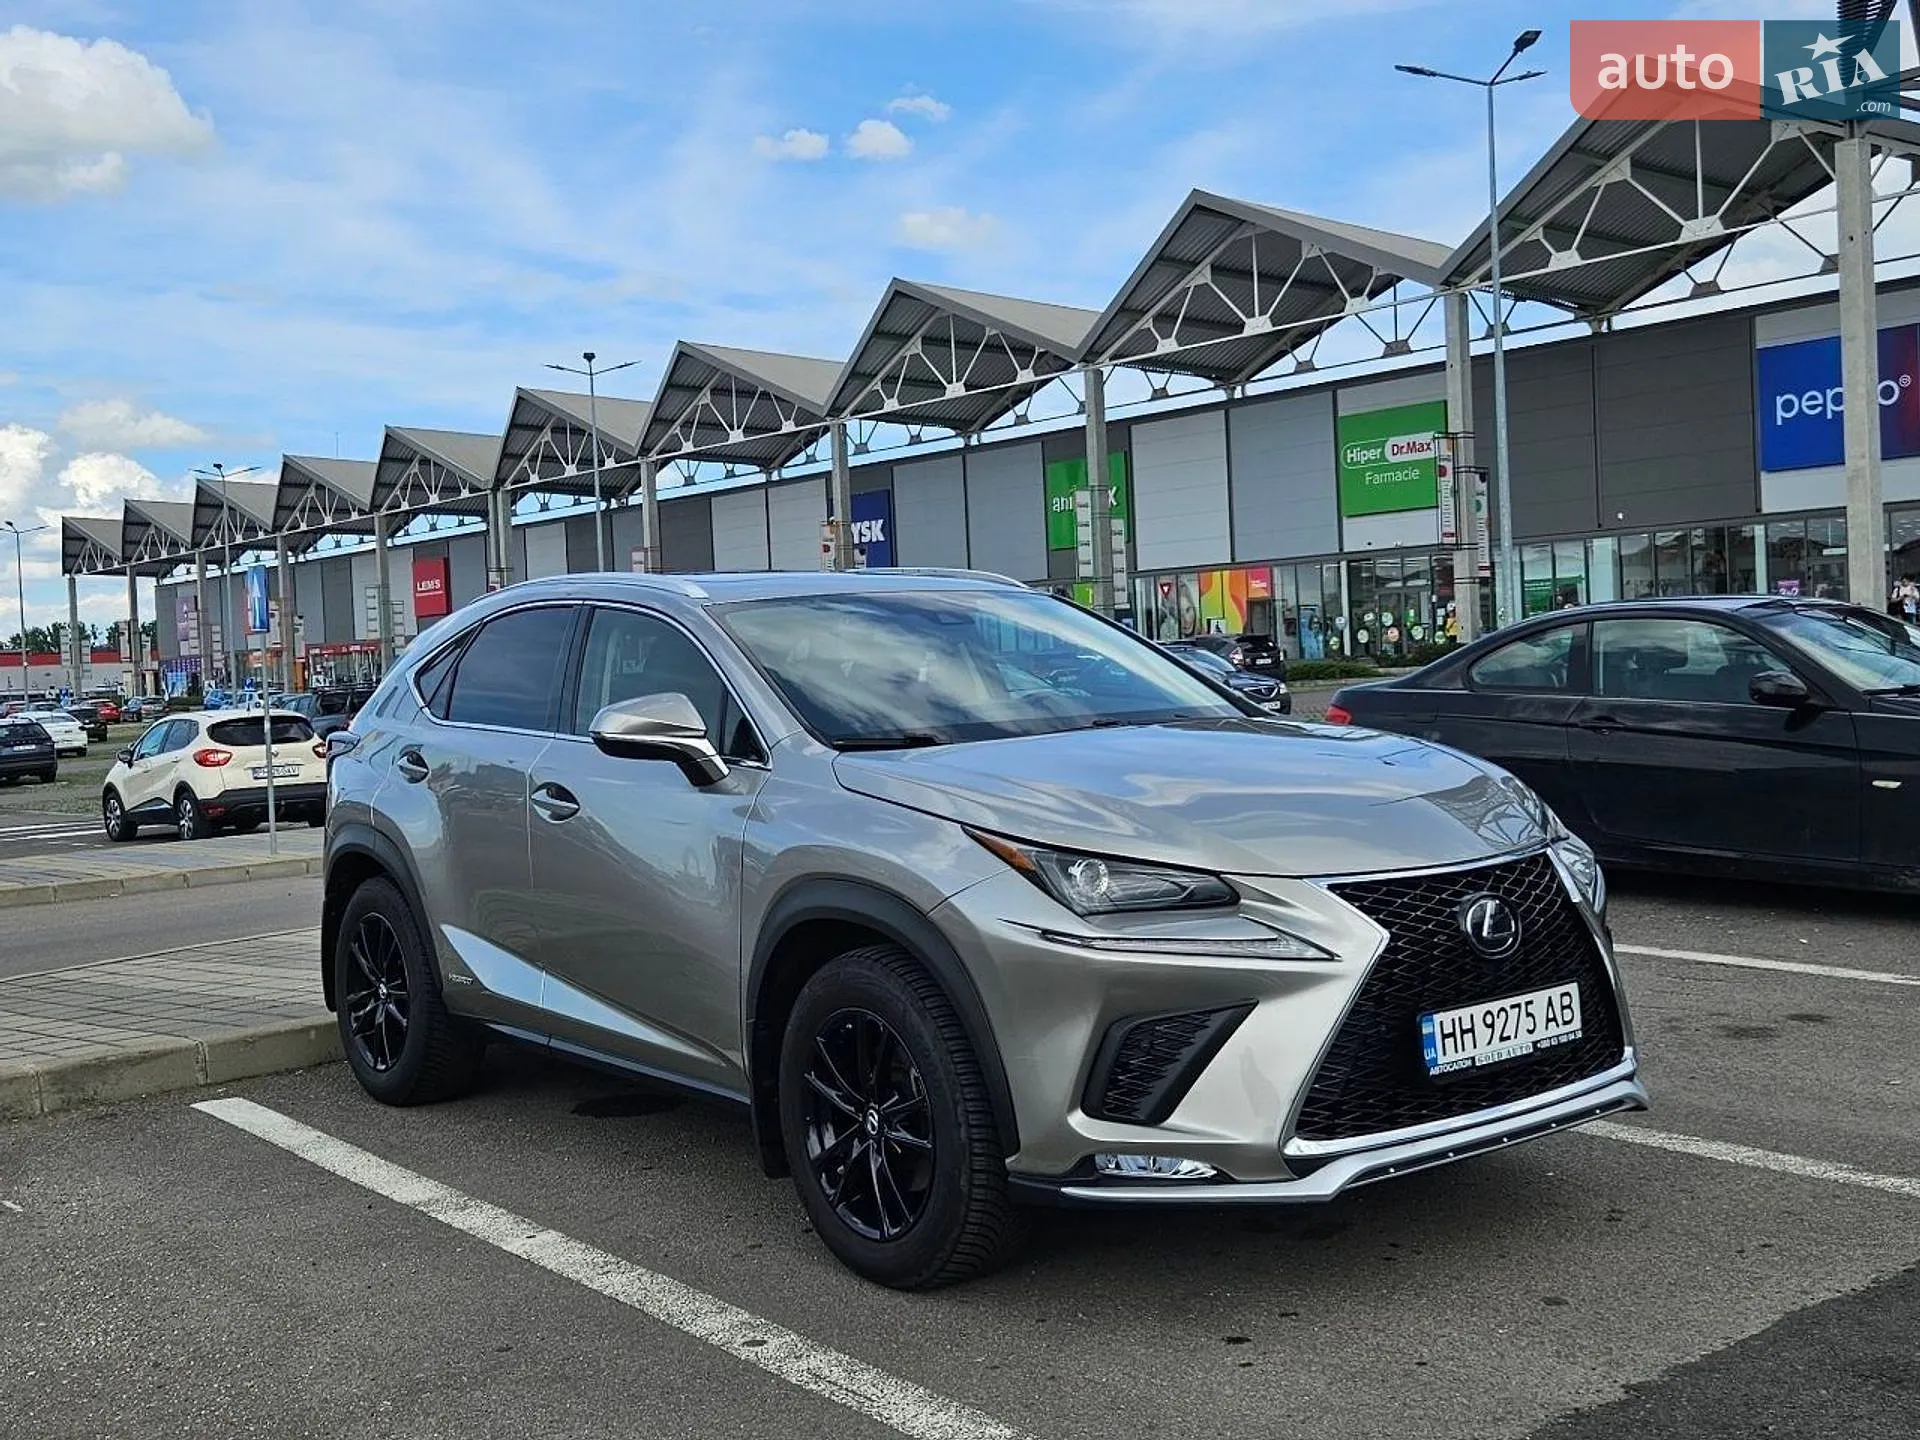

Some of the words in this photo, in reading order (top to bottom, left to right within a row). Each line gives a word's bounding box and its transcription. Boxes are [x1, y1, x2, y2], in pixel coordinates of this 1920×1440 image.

[1775, 379, 1900, 426] pepo
[1346, 445, 1383, 464] Hiper
[1391, 440, 1433, 457] Dr.Max
[1364, 467, 1420, 486] Farmacie
[851, 519, 885, 545] YSK
[1439, 1014, 1478, 1057] HH
[1482, 999, 1537, 1047] 9275
[1544, 991, 1575, 1031] AB
[1423, 1046, 1437, 1061] UA
